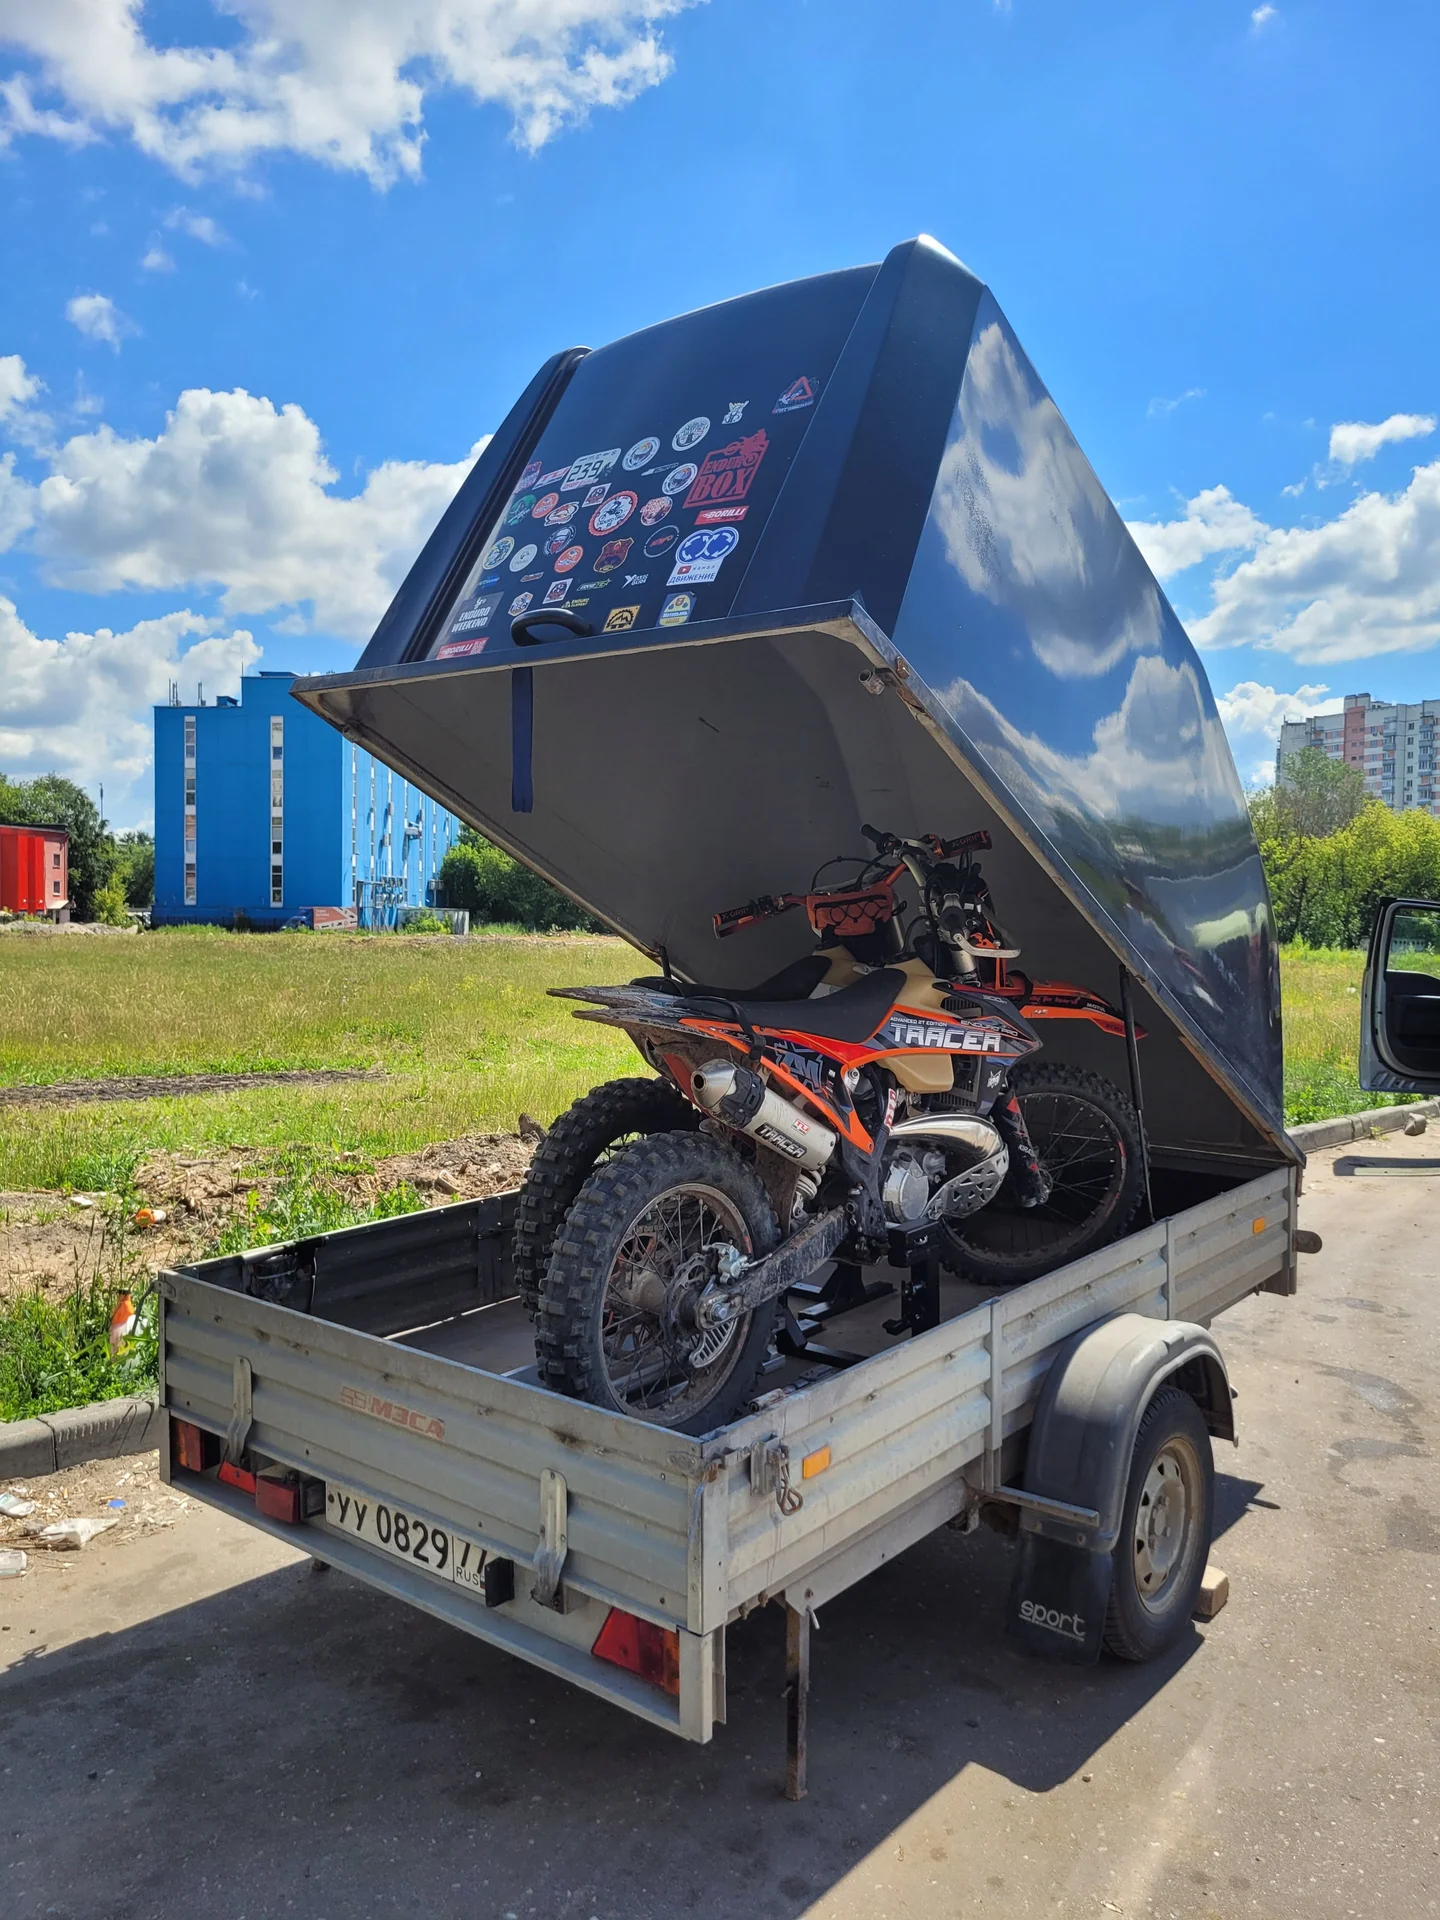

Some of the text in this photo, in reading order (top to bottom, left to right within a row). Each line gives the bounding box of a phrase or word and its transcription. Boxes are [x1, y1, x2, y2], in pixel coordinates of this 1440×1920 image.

[567, 461, 603, 483] 239
[705, 452, 759, 474] ENDURO
[696, 467, 752, 499] BOX
[707, 508, 746, 518] BORILLI
[668, 572, 716, 585] ДВИЖЕНИЕ
[458, 606, 491, 622] ENDURO
[451, 617, 488, 633] WEEKEND
[890, 1016, 918, 1024] ADVANCED
[960, 1019, 1019, 1037] ENDURO PRO
[890, 1022, 1002, 1052] TRACER
[760, 1124, 806, 1158] TRACER
[376, 1504, 449, 1570] 0829
[456, 1566, 479, 1586] RUS
[1020, 1600, 1085, 1636] sport
